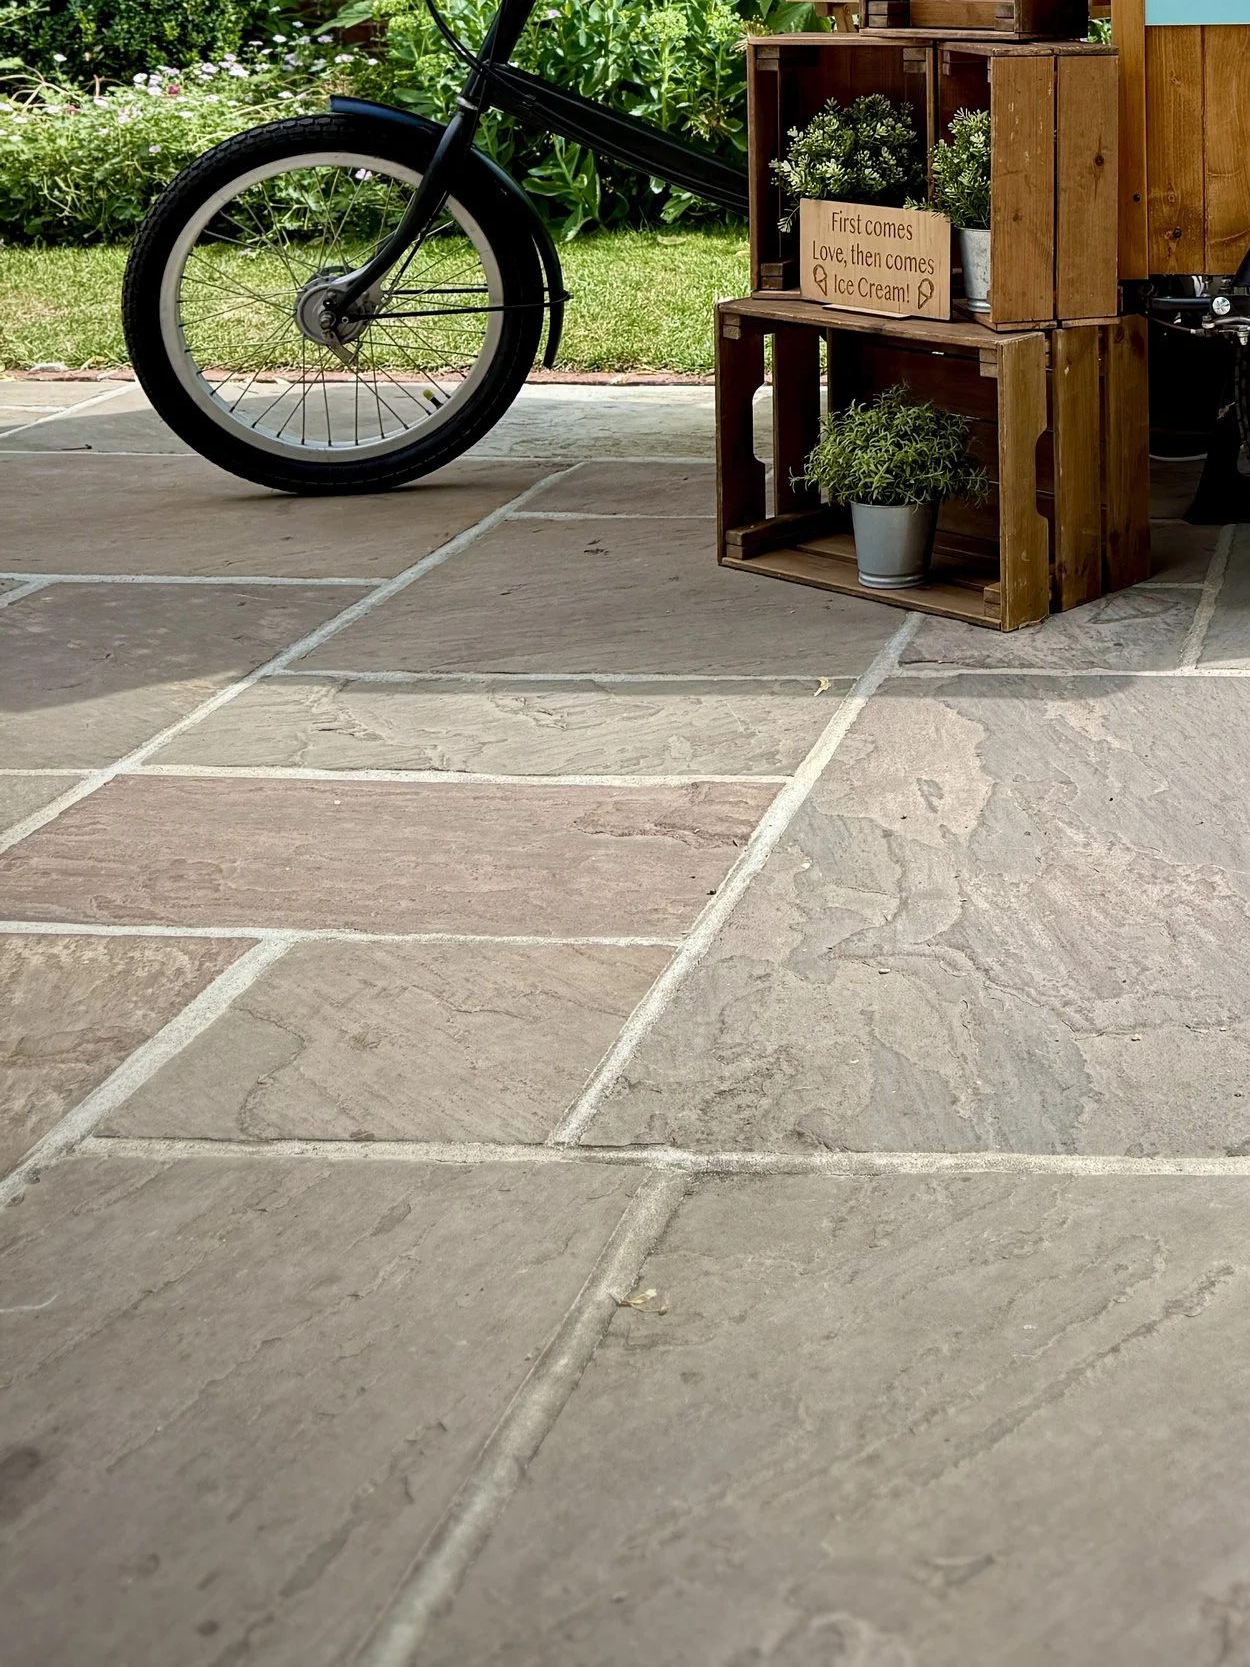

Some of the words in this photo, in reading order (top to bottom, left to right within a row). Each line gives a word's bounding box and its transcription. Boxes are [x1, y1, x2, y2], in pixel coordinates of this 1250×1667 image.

[831, 210, 862, 236] First
[864, 219, 914, 241] comes
[812, 240, 848, 268] Love,
[851, 243, 882, 268] then
[885, 252, 936, 276] comes
[834, 274, 855, 296] Ice
[857, 277, 911, 303] Cream!
